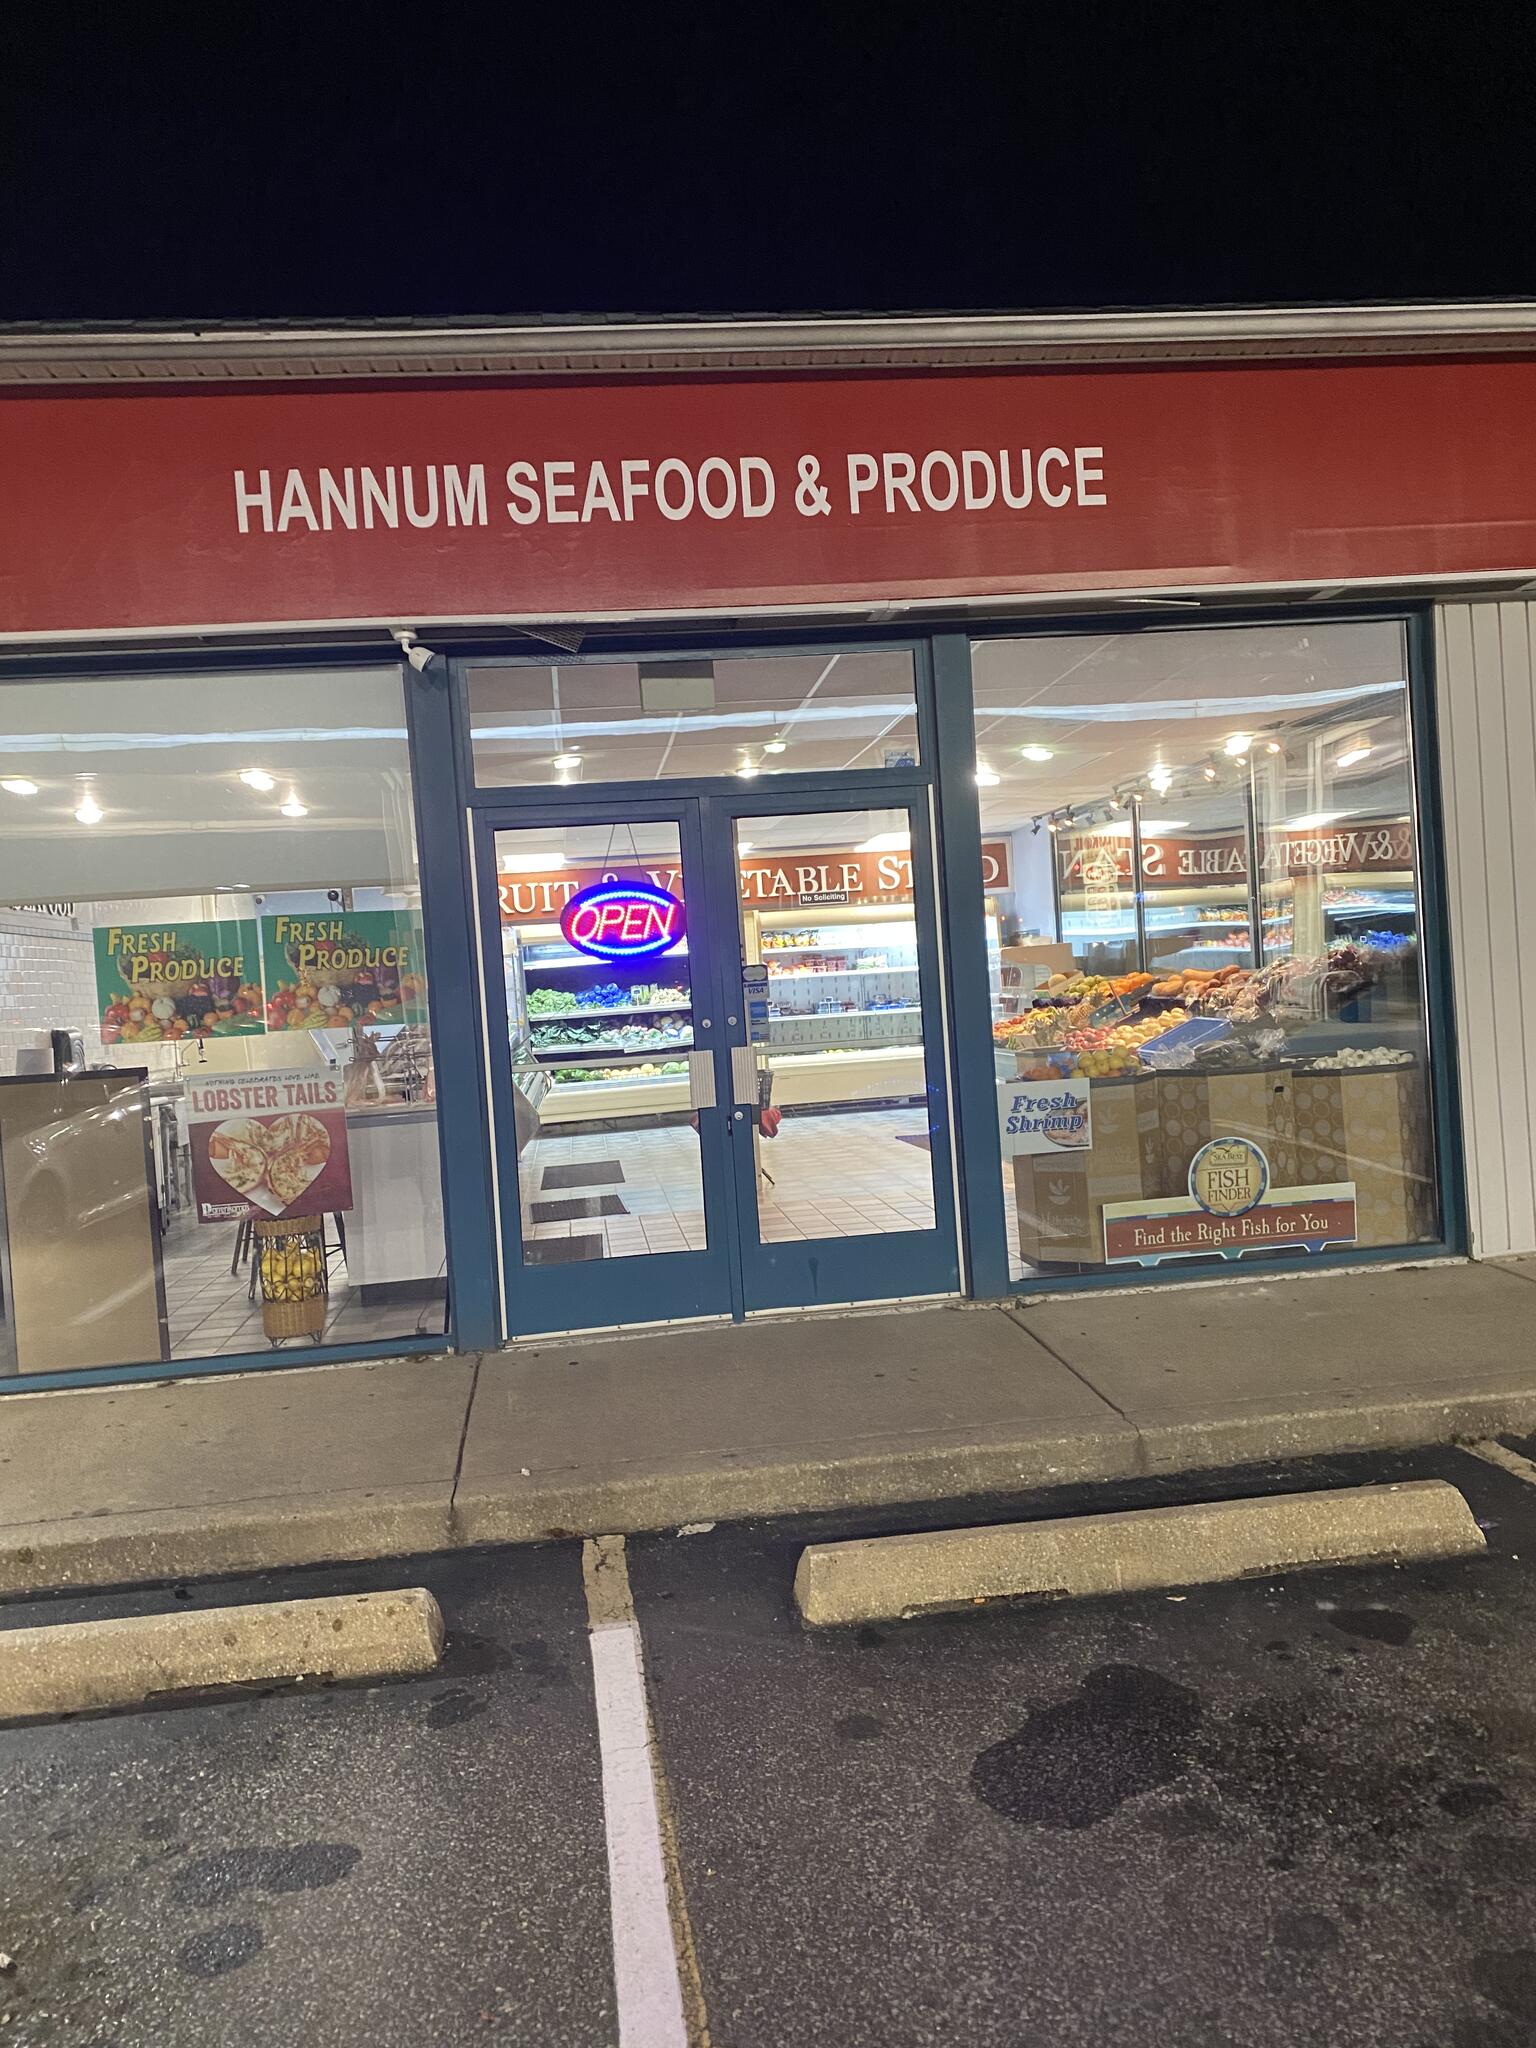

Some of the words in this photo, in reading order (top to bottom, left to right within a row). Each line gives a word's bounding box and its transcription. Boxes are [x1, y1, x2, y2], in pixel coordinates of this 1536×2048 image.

[234, 464, 488, 534] HANNUM
[507, 457, 777, 526] SEAFOOD
[795, 454, 832, 517] &
[848, 447, 1108, 514] PRODUCE
[497, 881, 579, 915] RUIT
[802, 894, 812, 902] No
[813, 892, 846, 901] Soliciting
[274, 915, 344, 944] FRESH
[571, 903, 675, 941] OPEN
[107, 927, 177, 957] FRESH
[131, 955, 244, 984] PRODUCE
[299, 943, 409, 972] PRODUCE
[748, 987, 764, 995] VISA
[192, 1085, 278, 1113] LOBSTER
[282, 1080, 337, 1106] TAILS
[1010, 1091, 1077, 1114] Fresh
[1006, 1113, 1084, 1135] Shrimp
[1207, 1168, 1250, 1190] FISH
[1207, 1187, 1251, 1202] FINDER
[1134, 1227, 1165, 1247] Find
[1170, 1226, 1191, 1242] the
[1197, 1222, 1236, 1246] Right
[1241, 1218, 1270, 1236] Fish
[1275, 1216, 1297, 1233] for
[1300, 1213, 1329, 1231] You
